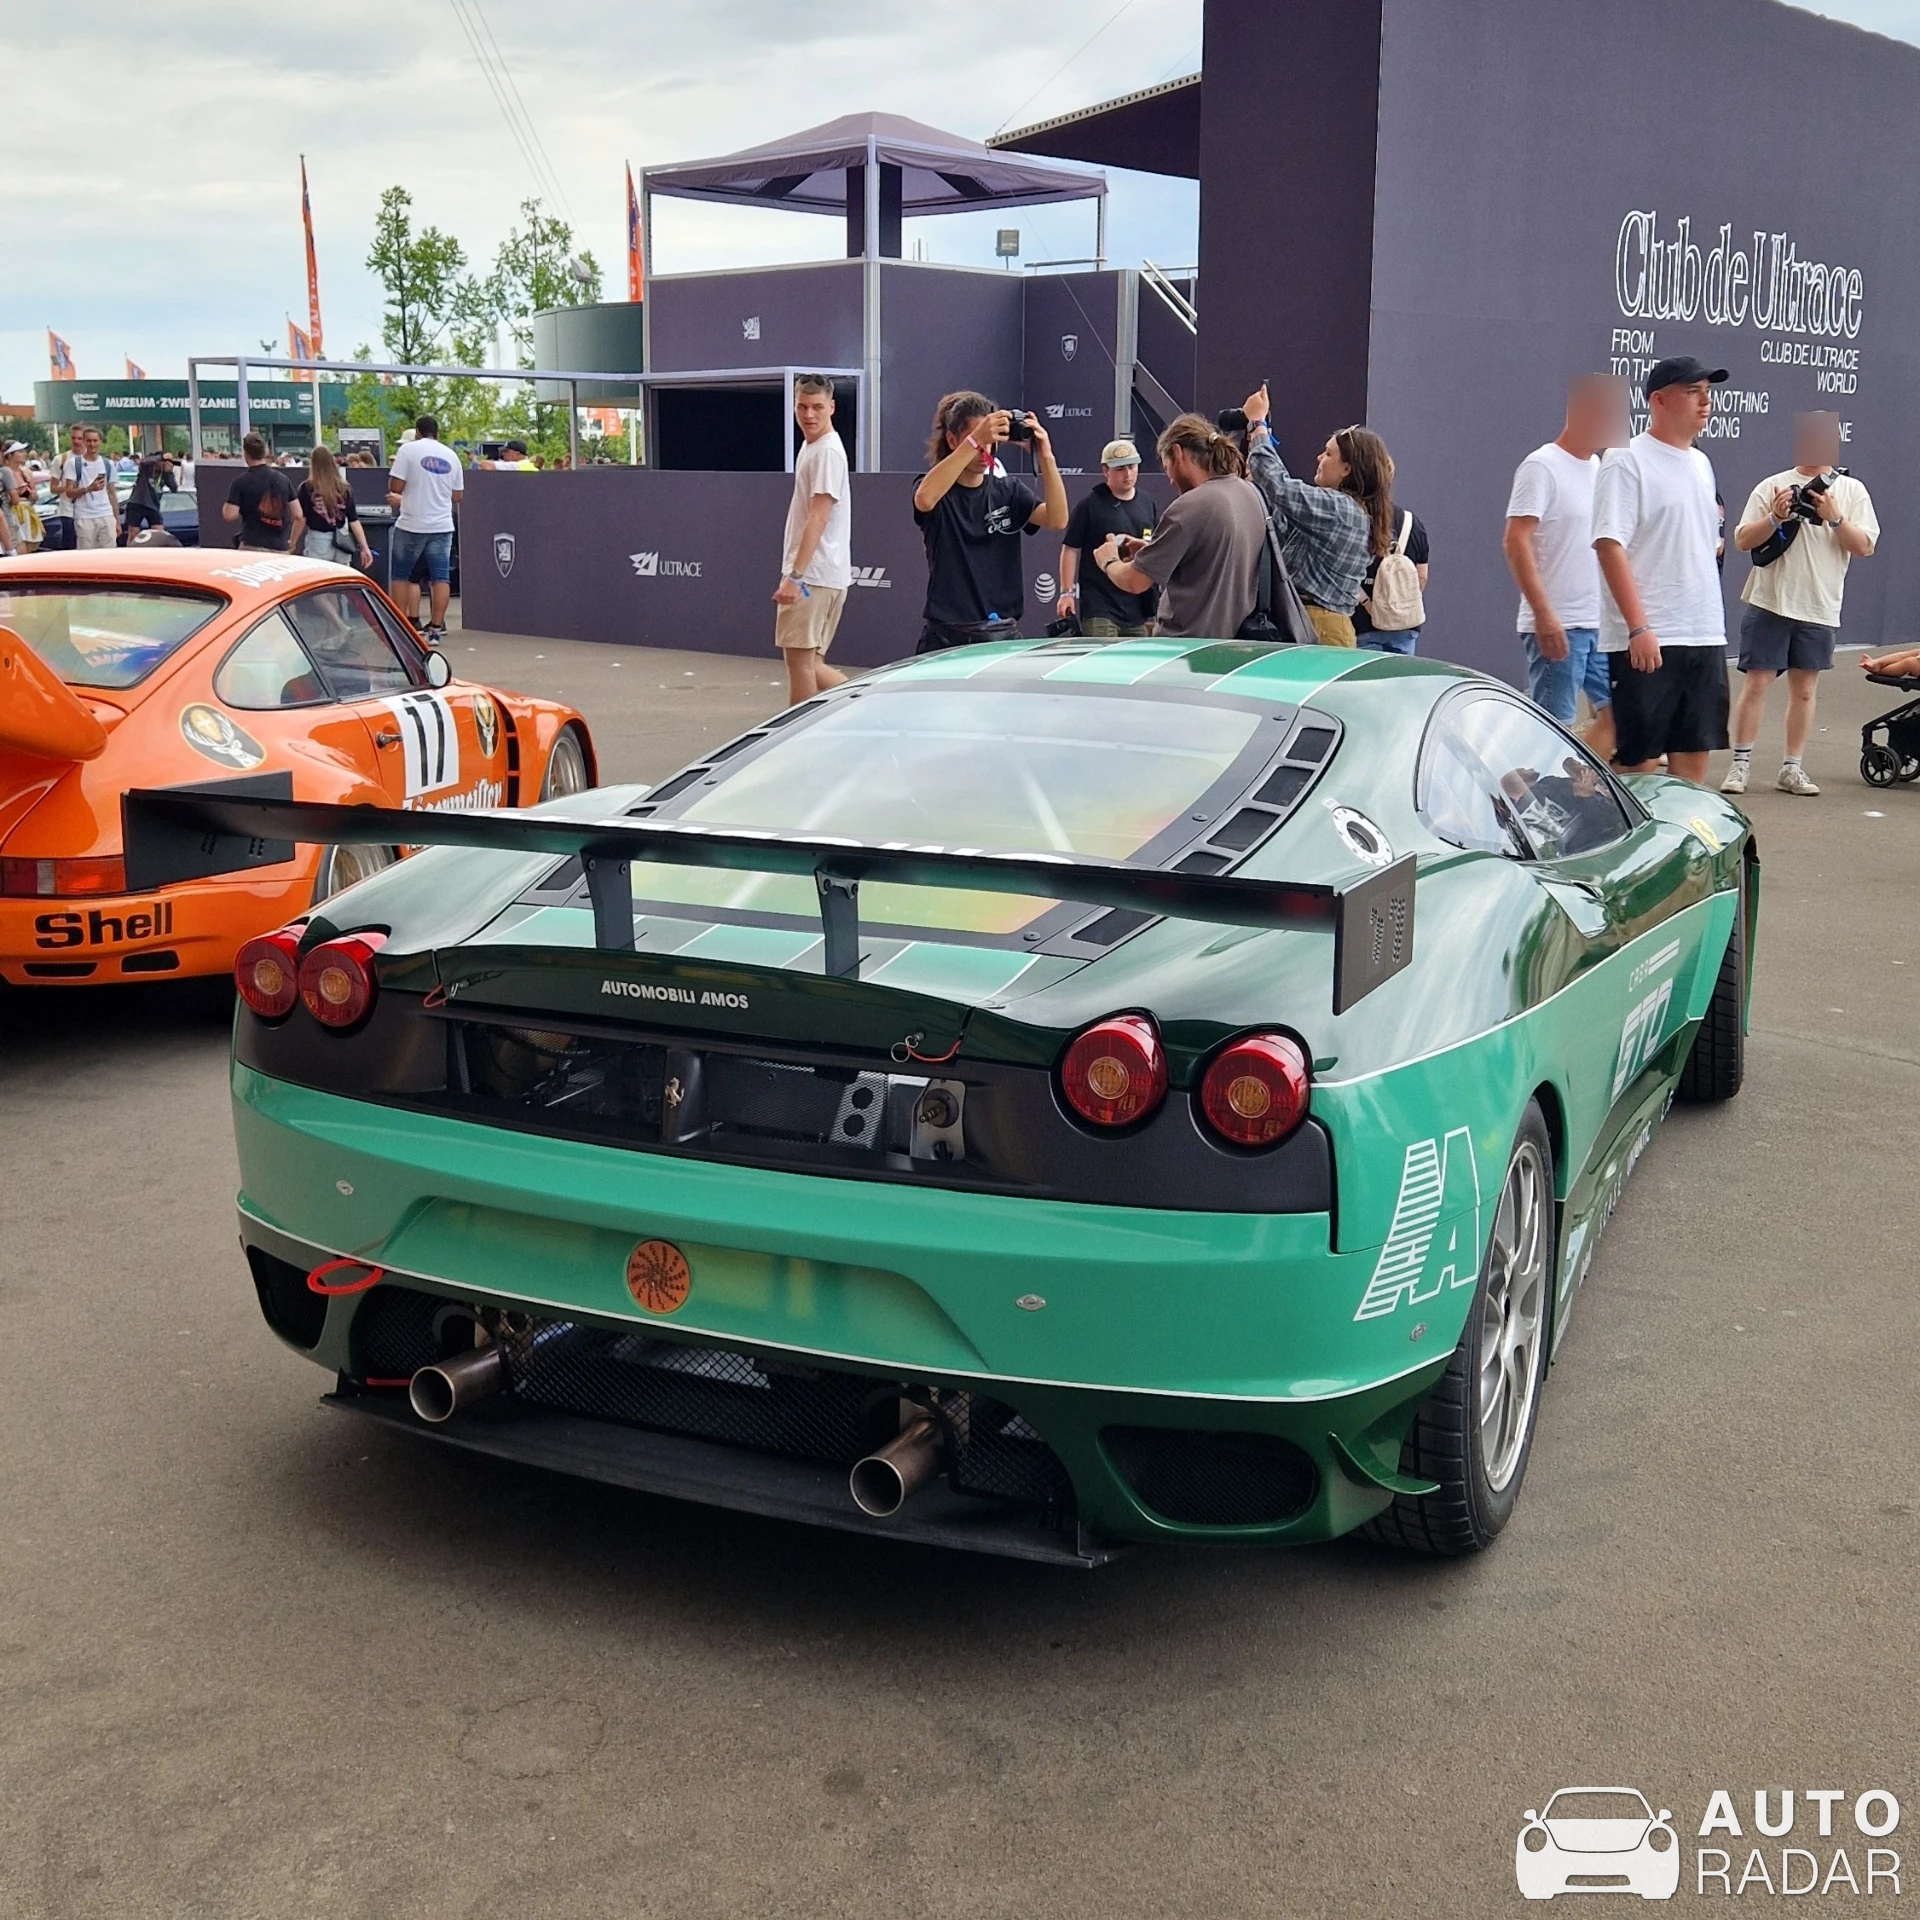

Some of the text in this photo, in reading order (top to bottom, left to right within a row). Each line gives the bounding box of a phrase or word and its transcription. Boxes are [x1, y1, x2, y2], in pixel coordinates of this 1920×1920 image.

[1615, 210, 1863, 339] Club de Ultrace
[1610, 328, 1655, 354] FROM
[1760, 340, 1860, 370] CLUB DE ULTRACE
[1817, 370, 1857, 394] WORLD
[105, 397, 155, 409] MUZEUM
[159, 397, 237, 409] ZWIEZANIE
[248, 398, 291, 410] ICKETS
[1064, 407, 1093, 417] ULTRACE
[1712, 390, 1770, 414] NOTHING
[1698, 416, 1741, 439] ACING
[659, 560, 703, 577] ULTRACE
[35, 902, 172, 948] Shell
[601, 980, 749, 1009] AUTOMOBILI AMOS
